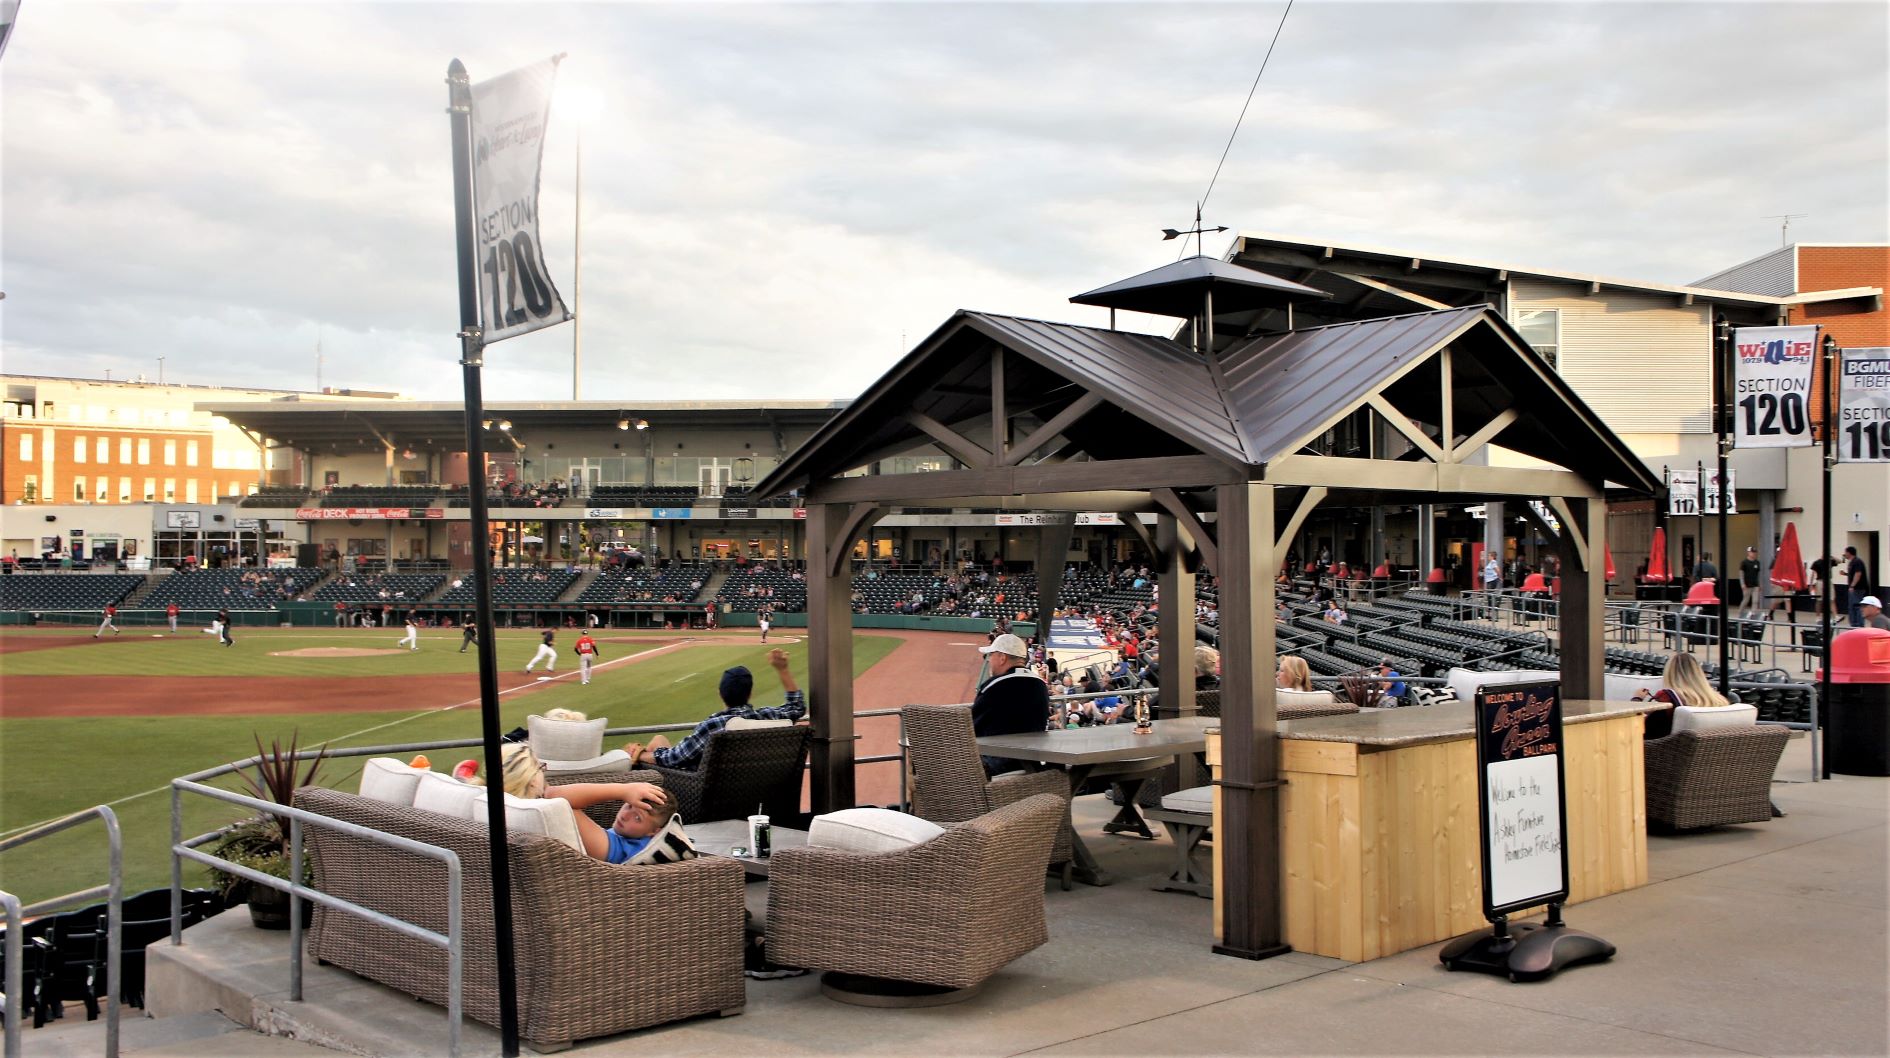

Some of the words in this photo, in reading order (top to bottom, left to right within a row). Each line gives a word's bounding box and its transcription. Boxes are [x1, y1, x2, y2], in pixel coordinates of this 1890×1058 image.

[482, 196, 532, 245] SECTION
[484, 231, 551, 330] 120
[1738, 378, 1806, 393] SECTION
[1739, 393, 1805, 436] 120
[1843, 407, 1890, 420] SECTIO
[1846, 421, 1890, 459] 119
[1674, 499, 1694, 513] 117
[323, 509, 348, 518] DECK
[1020, 515, 1033, 524] The
[1485, 693, 1514, 704] WELCOME
[1515, 692, 1524, 702] TO
[1523, 743, 1557, 757] BALLPARK
[1519, 776, 1527, 796] to
[1529, 776, 1541, 797] the
